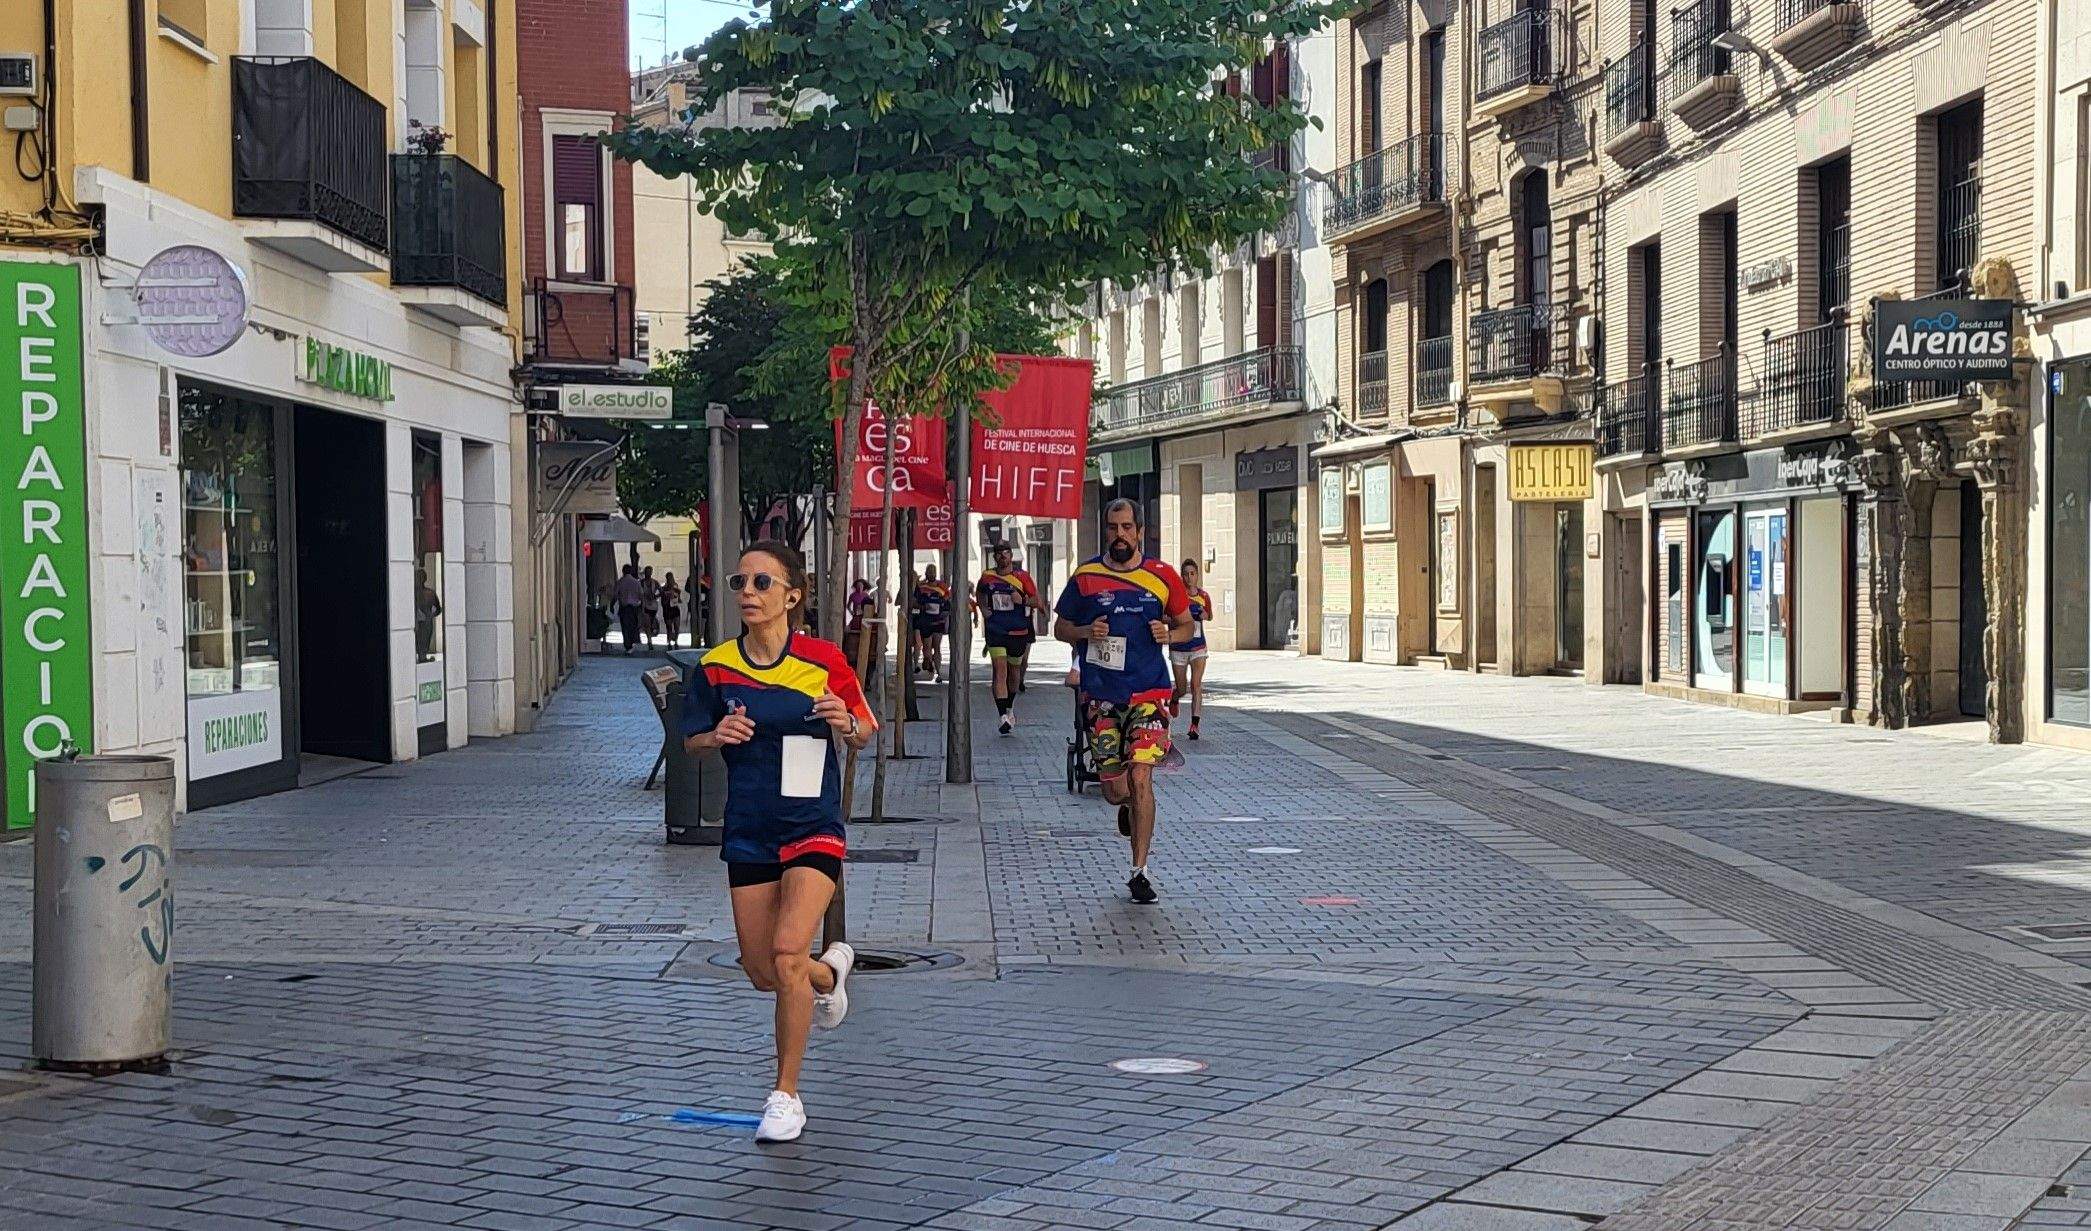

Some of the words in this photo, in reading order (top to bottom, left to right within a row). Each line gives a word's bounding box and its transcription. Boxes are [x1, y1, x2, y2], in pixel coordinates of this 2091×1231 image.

[1959, 321, 1982, 329] desde
[1885, 324, 2007, 355] Arenas
[1885, 360, 1921, 369] CENTRO
[1924, 357, 1955, 369] ÓPTICO
[1958, 359, 1965, 368] Y
[1966, 359, 2008, 368] AUDITIVO
[568, 388, 668, 408] el.estudio
[865, 422, 911, 453] es
[984, 429, 1018, 438] FESTIVAL
[1019, 429, 1077, 438] INTERNACIONAL
[984, 439, 998, 450] DE
[999, 440, 1021, 452] CINE
[1022, 442, 1036, 453] DE
[1037, 443, 1076, 456] HUESCA
[1515, 448, 1587, 488] ASCASO
[866, 465, 915, 492] ca
[980, 464, 1075, 502] HIFF
[1516, 490, 1587, 498] PASTELERIA
[926, 505, 951, 521] es
[926, 527, 951, 542] ca
[204, 710, 269, 754] REPARACIONES
